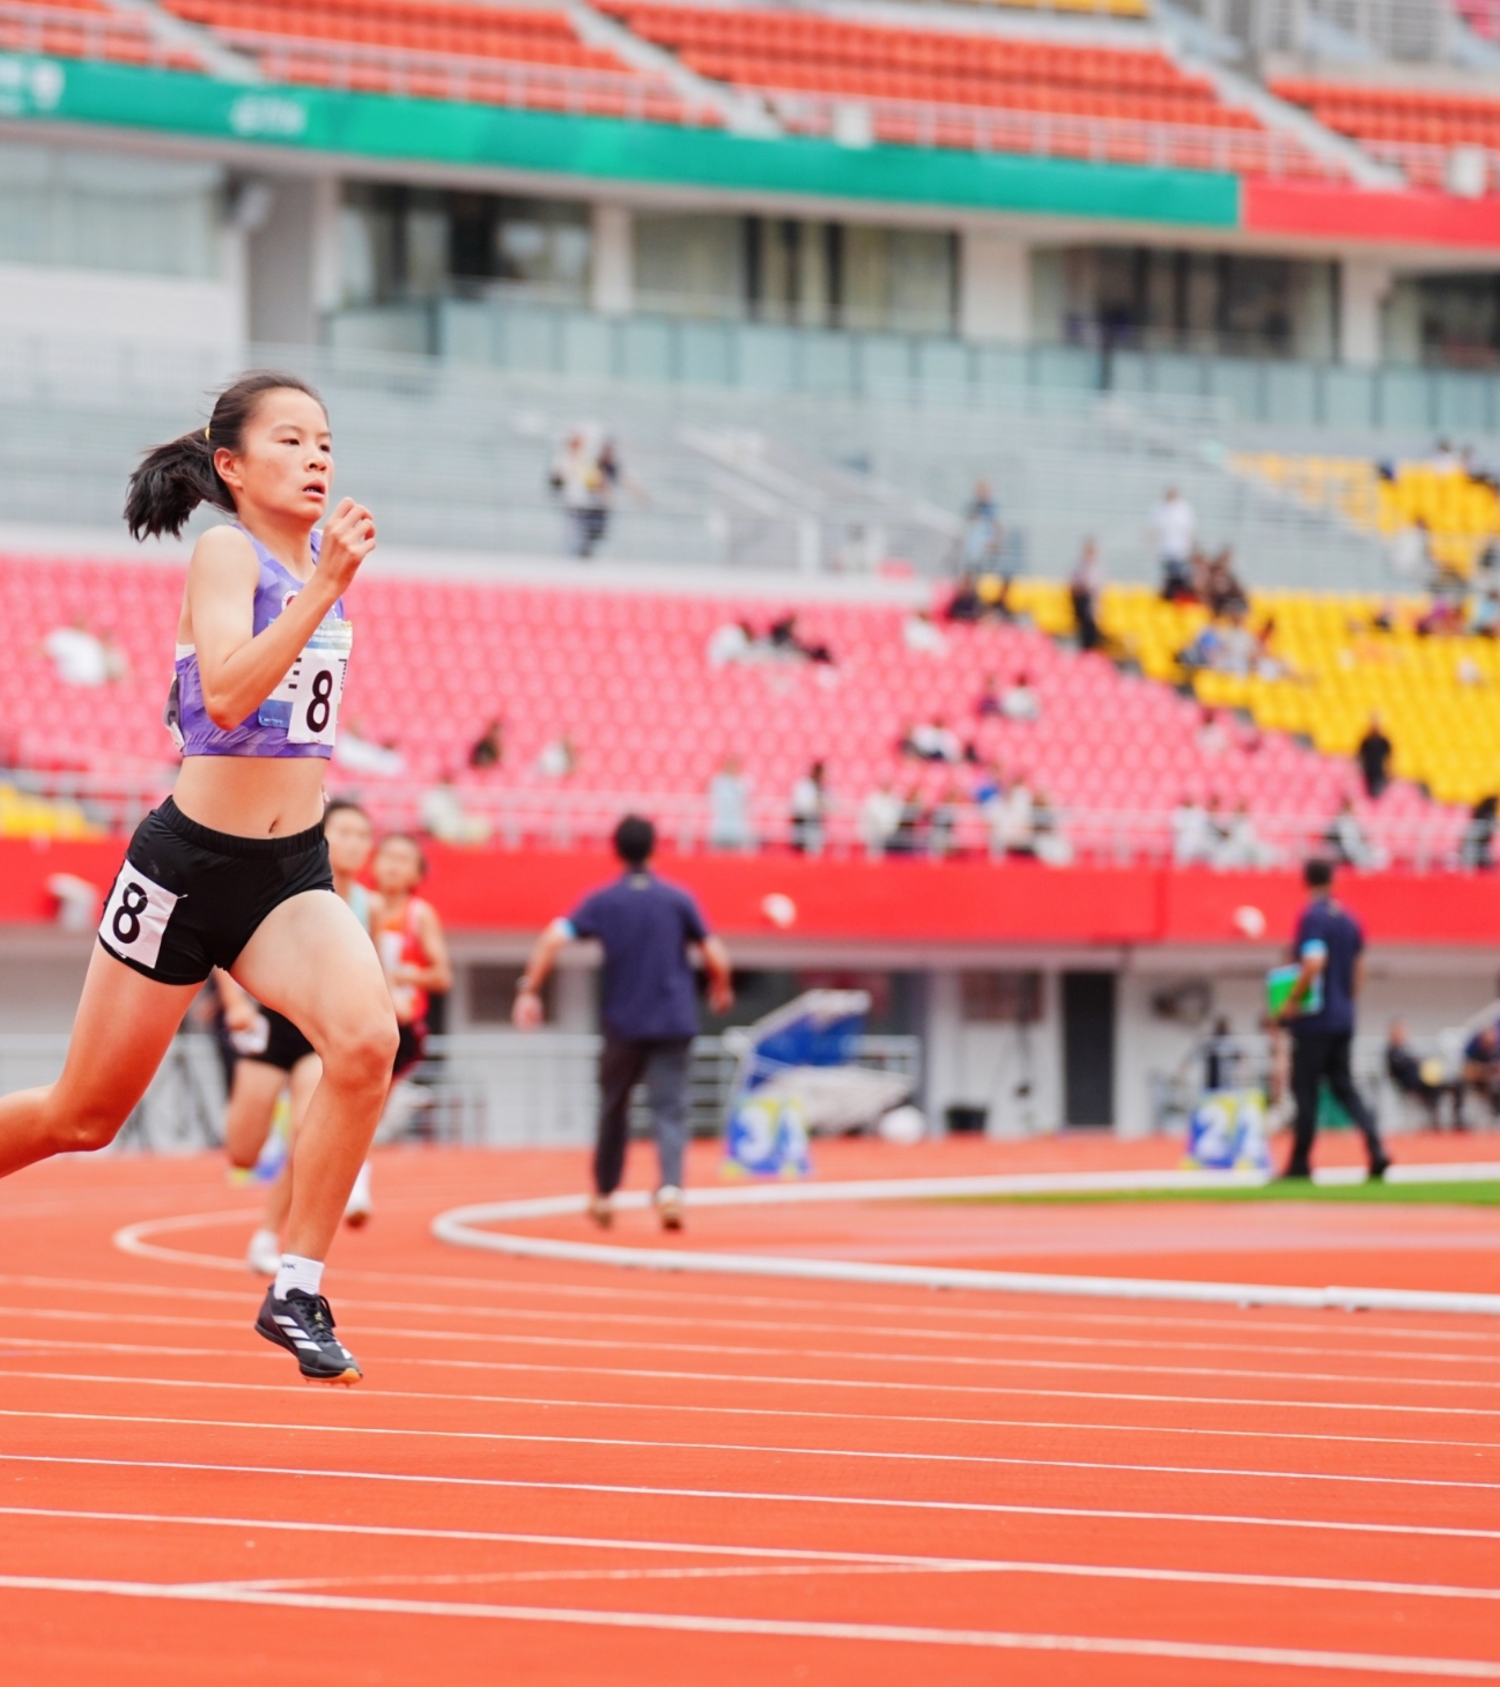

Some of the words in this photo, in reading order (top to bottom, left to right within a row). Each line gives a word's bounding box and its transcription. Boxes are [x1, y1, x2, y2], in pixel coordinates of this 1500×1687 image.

[306, 669, 333, 733] 8
[112, 882, 148, 944] 8
[1195, 1103, 1228, 1160] 2
